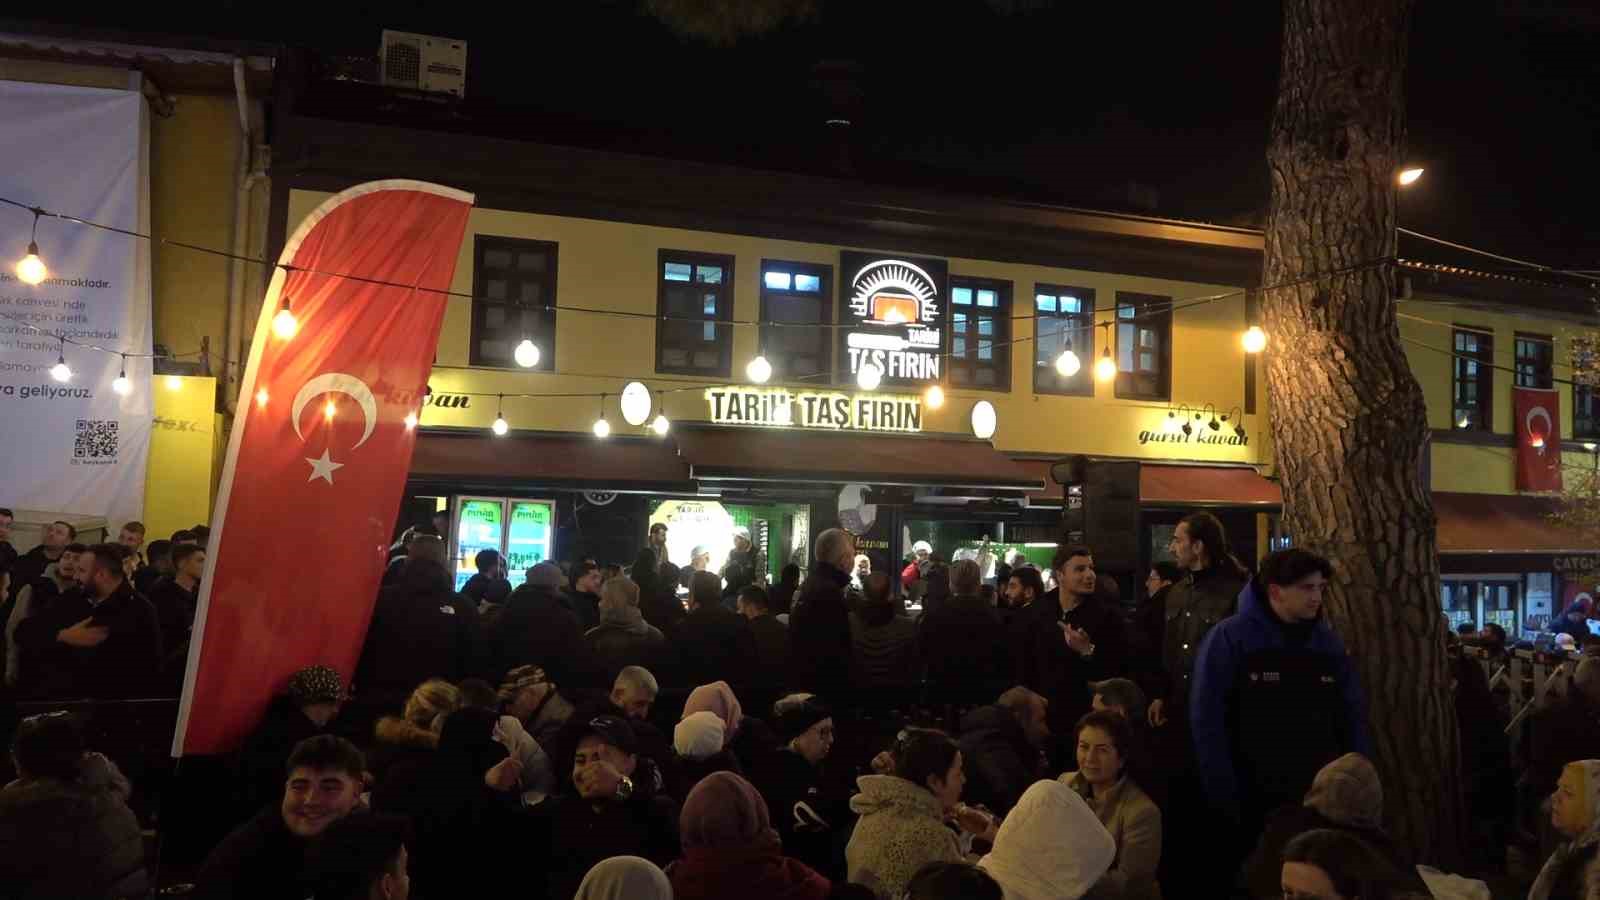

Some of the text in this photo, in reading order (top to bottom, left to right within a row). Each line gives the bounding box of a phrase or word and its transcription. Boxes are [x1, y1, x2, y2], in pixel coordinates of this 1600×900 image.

[888, 350, 940, 380] FIRIN
[20, 384, 93, 400] geliyoruz.
[803, 396, 850, 429] TAŞ
[857, 399, 921, 430] FIRIN
